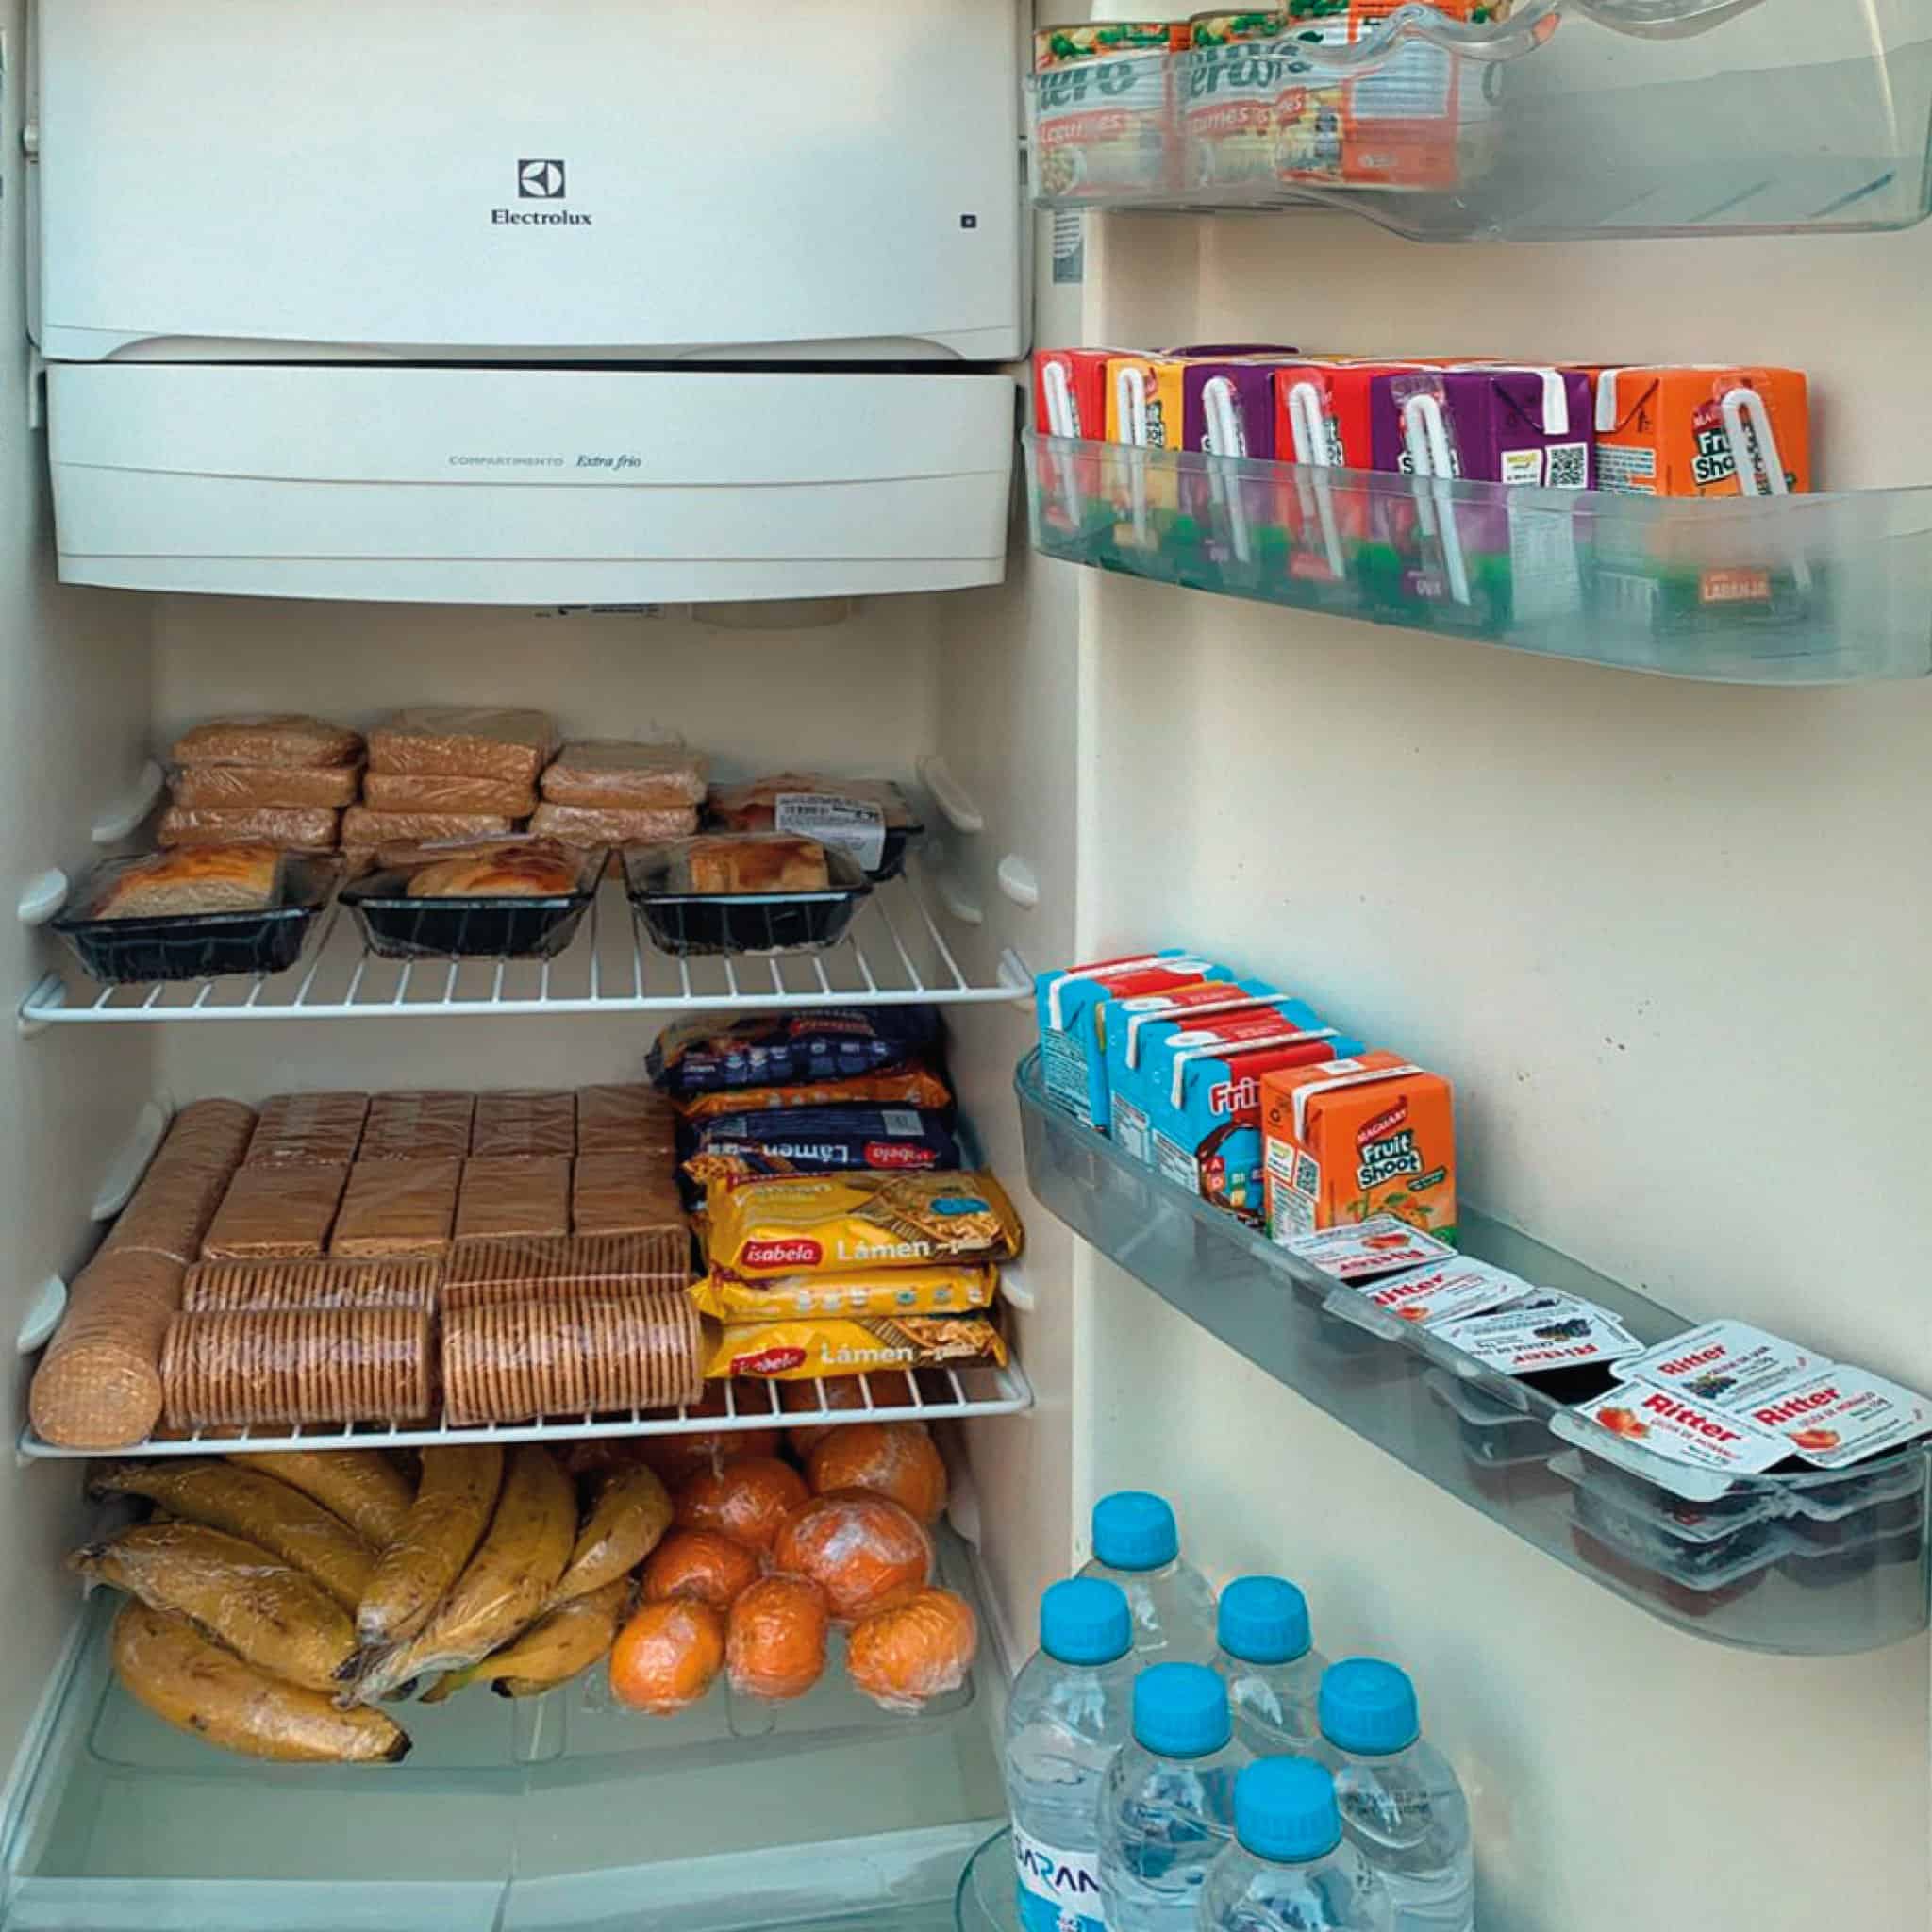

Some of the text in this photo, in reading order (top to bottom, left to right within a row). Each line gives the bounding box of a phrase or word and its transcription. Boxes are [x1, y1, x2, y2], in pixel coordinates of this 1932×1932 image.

[491, 209, 592, 225] Electrolux
[576, 455, 612, 468] Extra
[1362, 1134, 1409, 1164] Fruit
[1360, 1154, 1418, 1185] Shoot
[747, 1244, 816, 1262] isabela
[838, 1240, 930, 1261] Lámen
[821, 1343, 914, 1364] Lámen
[1657, 1344, 1728, 1376] Ritter
[1641, 1392, 1743, 1442] Ritter
[1753, 1386, 1841, 1427] Ritter
